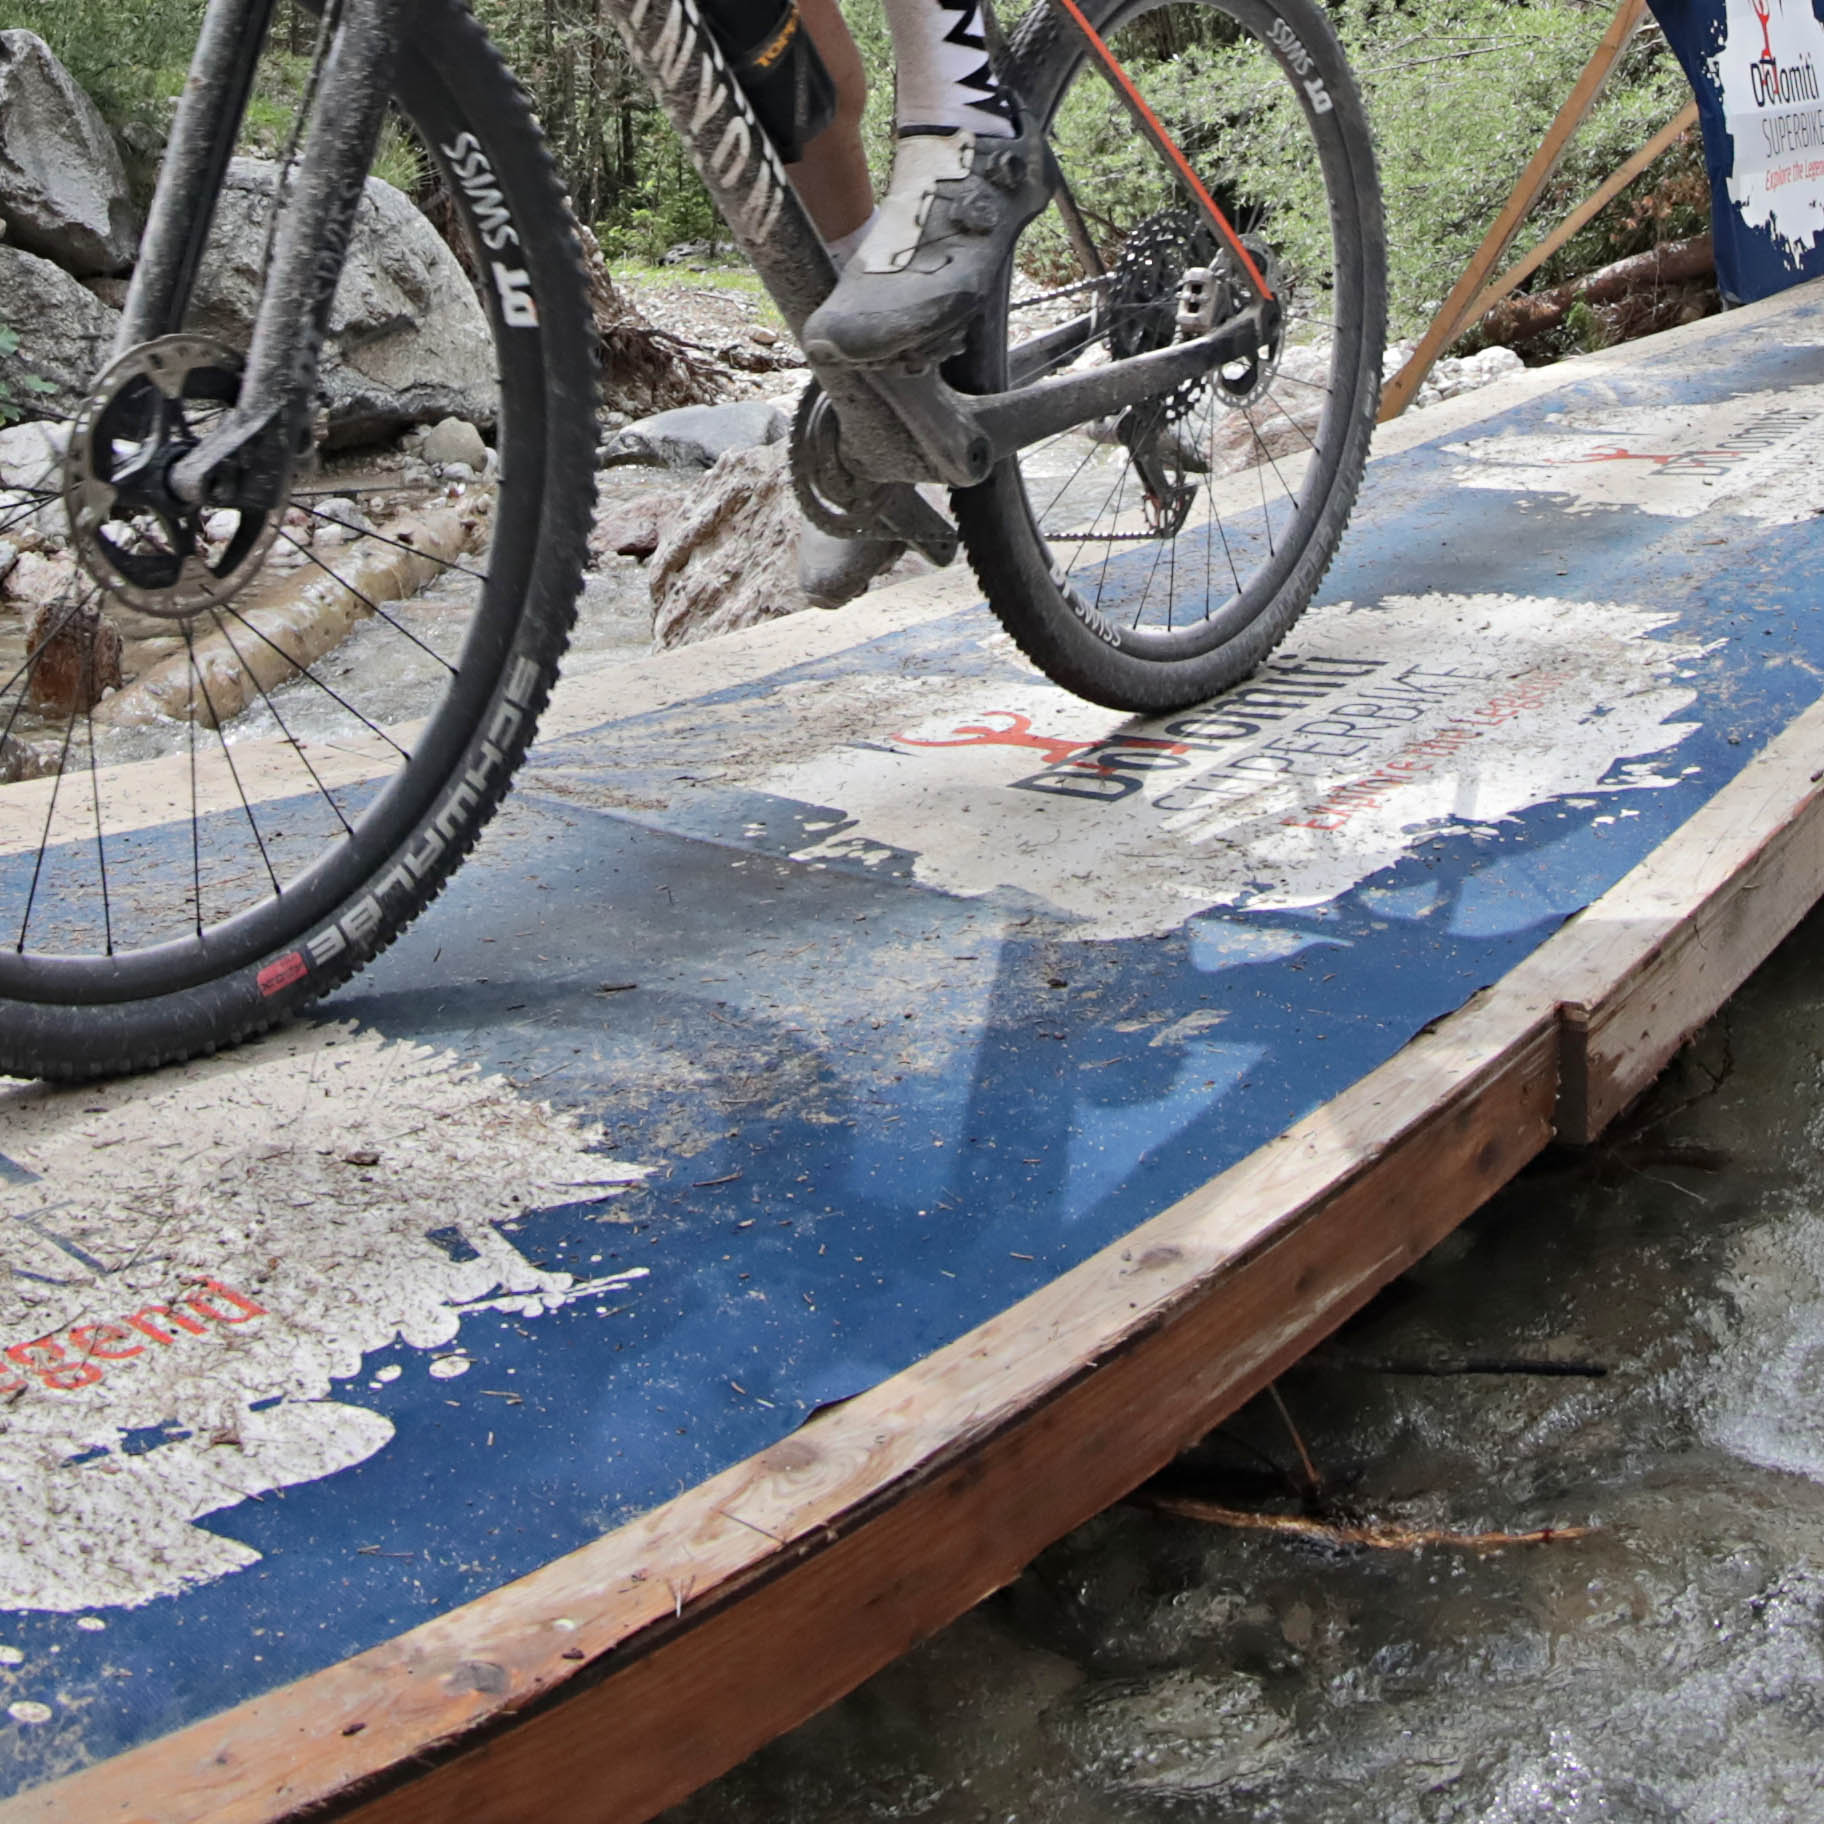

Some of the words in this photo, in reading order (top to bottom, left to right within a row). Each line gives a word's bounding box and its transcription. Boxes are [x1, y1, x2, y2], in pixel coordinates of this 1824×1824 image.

[1265, 17, 1315, 76] SWISS
[1303, 77, 1334, 115] DT
[1749, 52, 1820, 108] Dolomiti
[440, 131, 520, 250] SWISS
[491, 261, 539, 327] DT
[1075, 599, 1121, 647] SWISS
[306, 654, 541, 968] SCHWALBE
